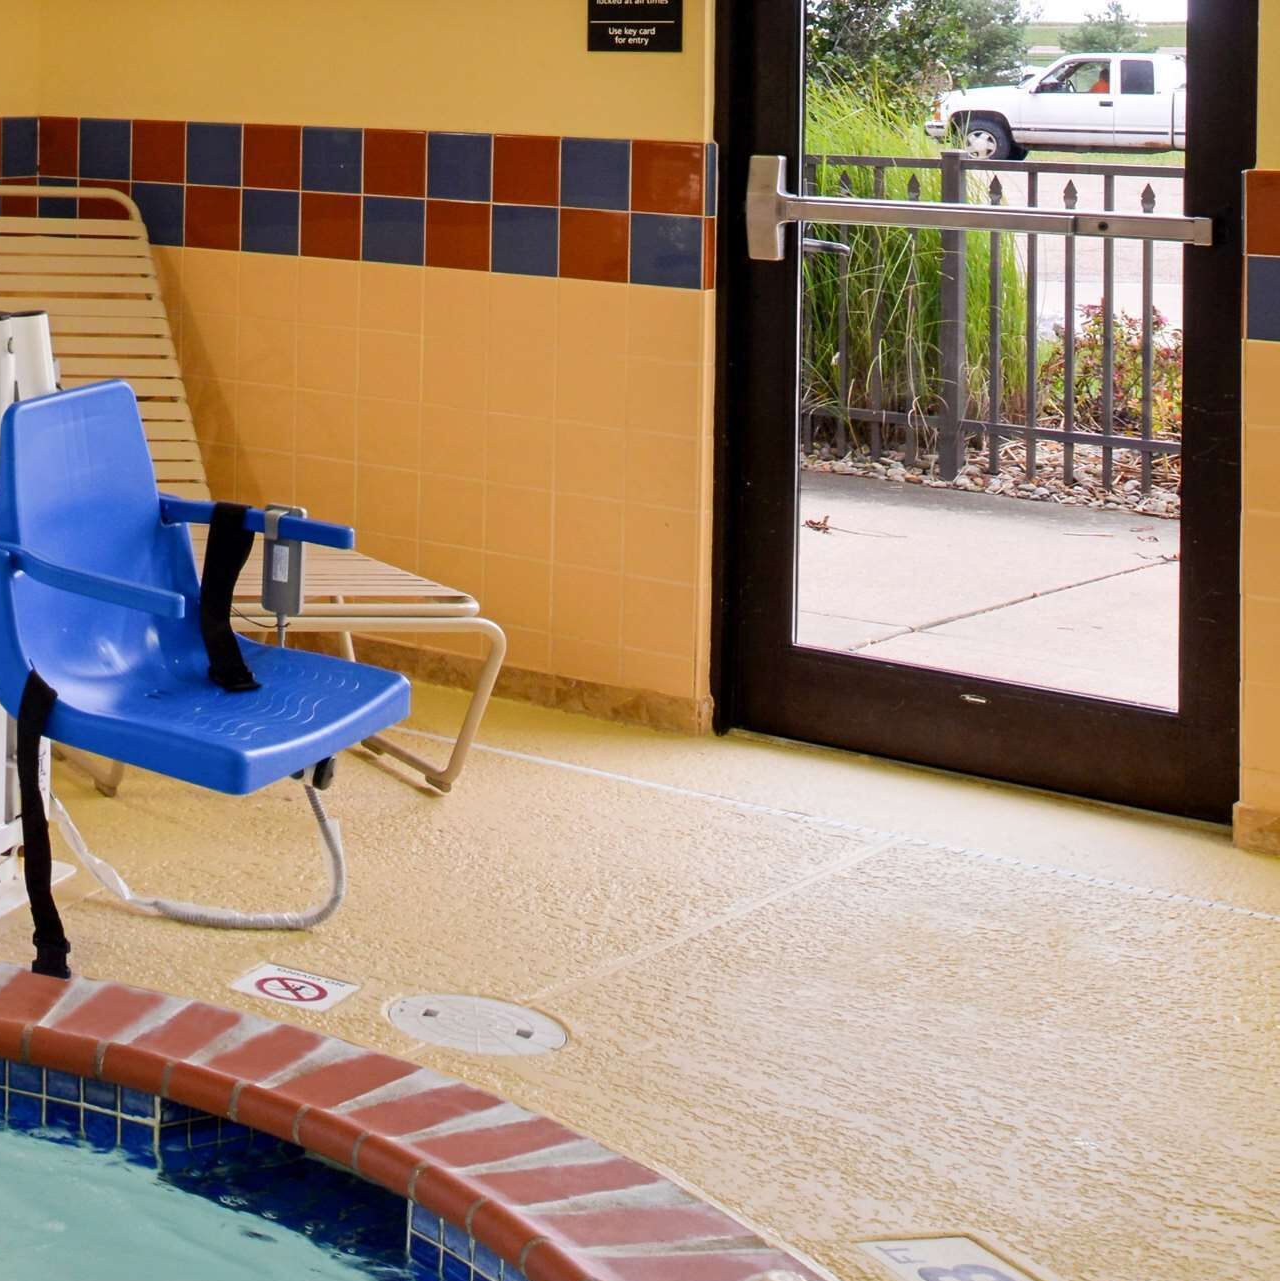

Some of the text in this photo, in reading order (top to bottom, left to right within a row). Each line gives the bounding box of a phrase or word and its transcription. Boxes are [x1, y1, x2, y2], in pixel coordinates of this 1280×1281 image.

[608, 27, 656, 37] Use key card
[615, 36, 649, 46] for entry
